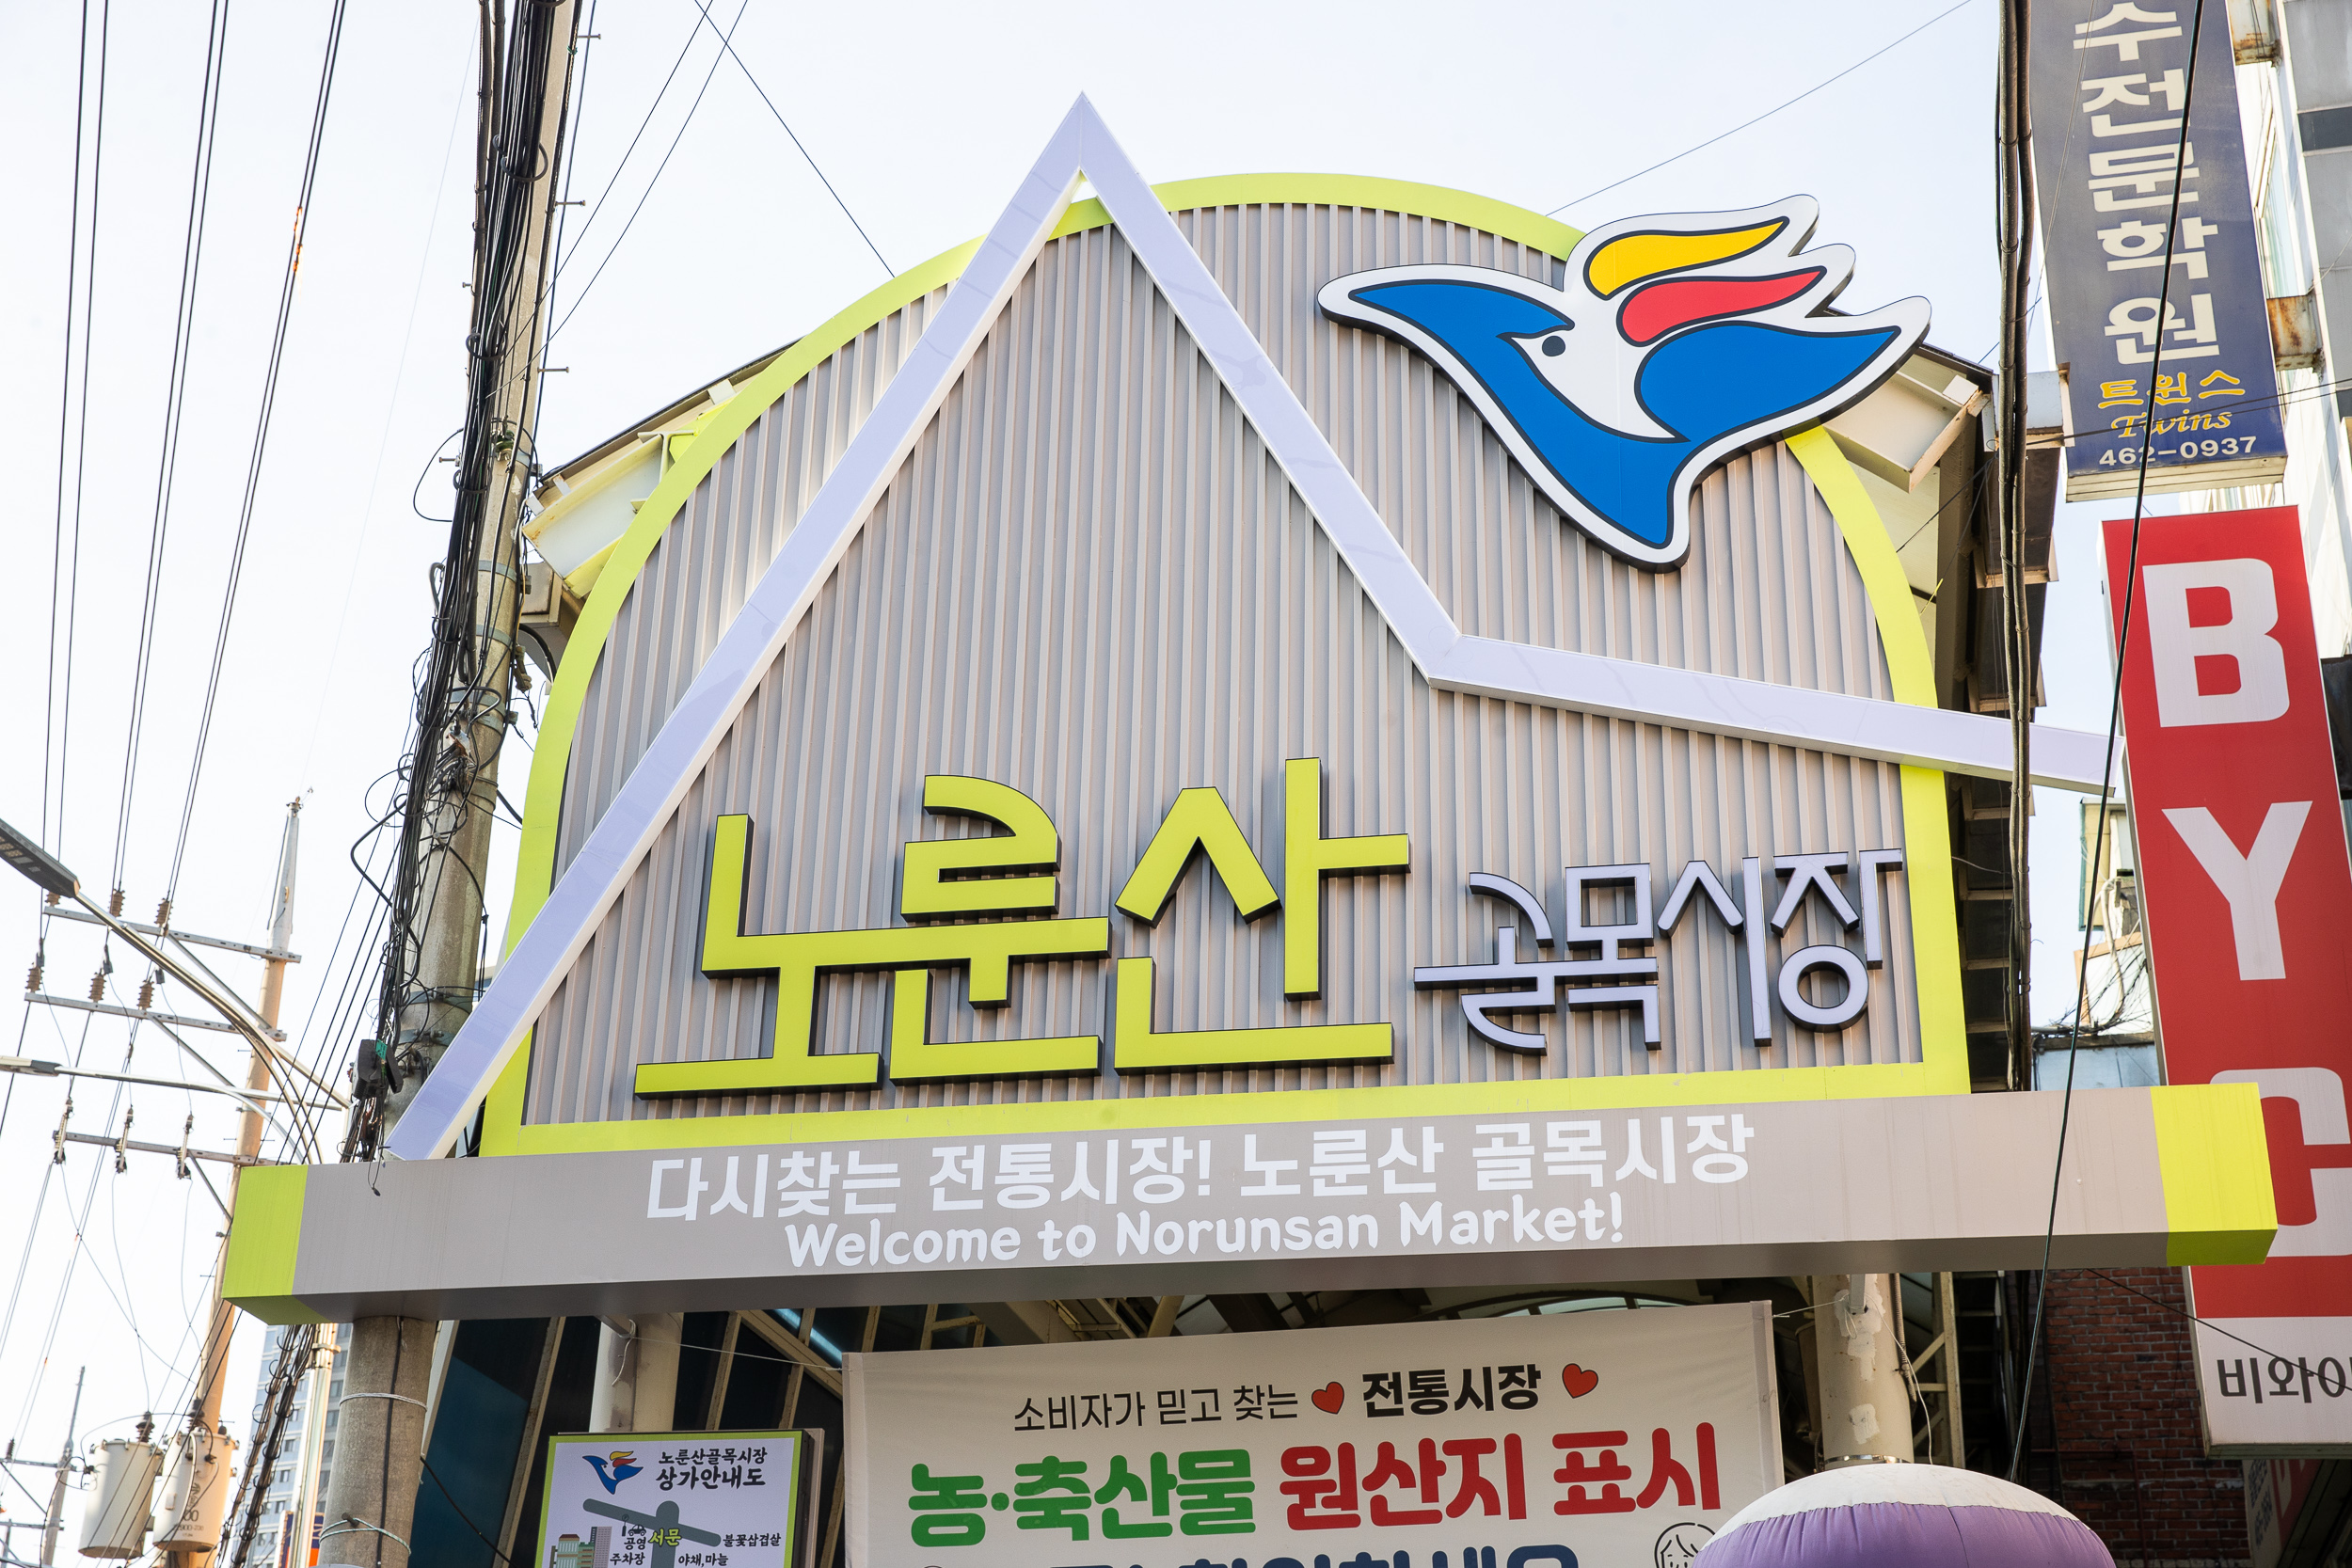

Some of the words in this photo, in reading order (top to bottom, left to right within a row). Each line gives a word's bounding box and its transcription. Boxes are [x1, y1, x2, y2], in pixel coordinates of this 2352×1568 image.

[2110, 409, 2233, 438] Twins
[2099, 436, 2257, 467] 462-0937
[634, 757, 1411, 1100] 노룬산
[1414, 847, 1904, 1056] 골목시장
[646, 1149, 901, 1222] 다시찾는
[930, 1135, 1212, 1212] 전통시장!
[1240, 1125, 1444, 1197] 노룬산
[1472, 1113, 1755, 1191] 골목시장
[784, 1218, 1021, 1268] Welcome
[1037, 1219, 1097, 1262] to
[1116, 1210, 1379, 1257] Norunsan
[1399, 1191, 1624, 1247] Market!
[1014, 1391, 1146, 1432] 소비자가
[1156, 1388, 1222, 1425] 믿고
[1233, 1384, 1298, 1421] 찾는
[1361, 1363, 1542, 1418] 전통시장
[659, 1447, 768, 1465] 노룬산골목시장
[656, 1465, 767, 1491] 상가안내도
[1279, 1433, 1528, 1531] 원산지
[1551, 1421, 1722, 1516] 표시
[624, 1537, 646, 1550] 공영
[648, 1528, 682, 1546] 서문
[610, 1552, 645, 1566] 주차장
